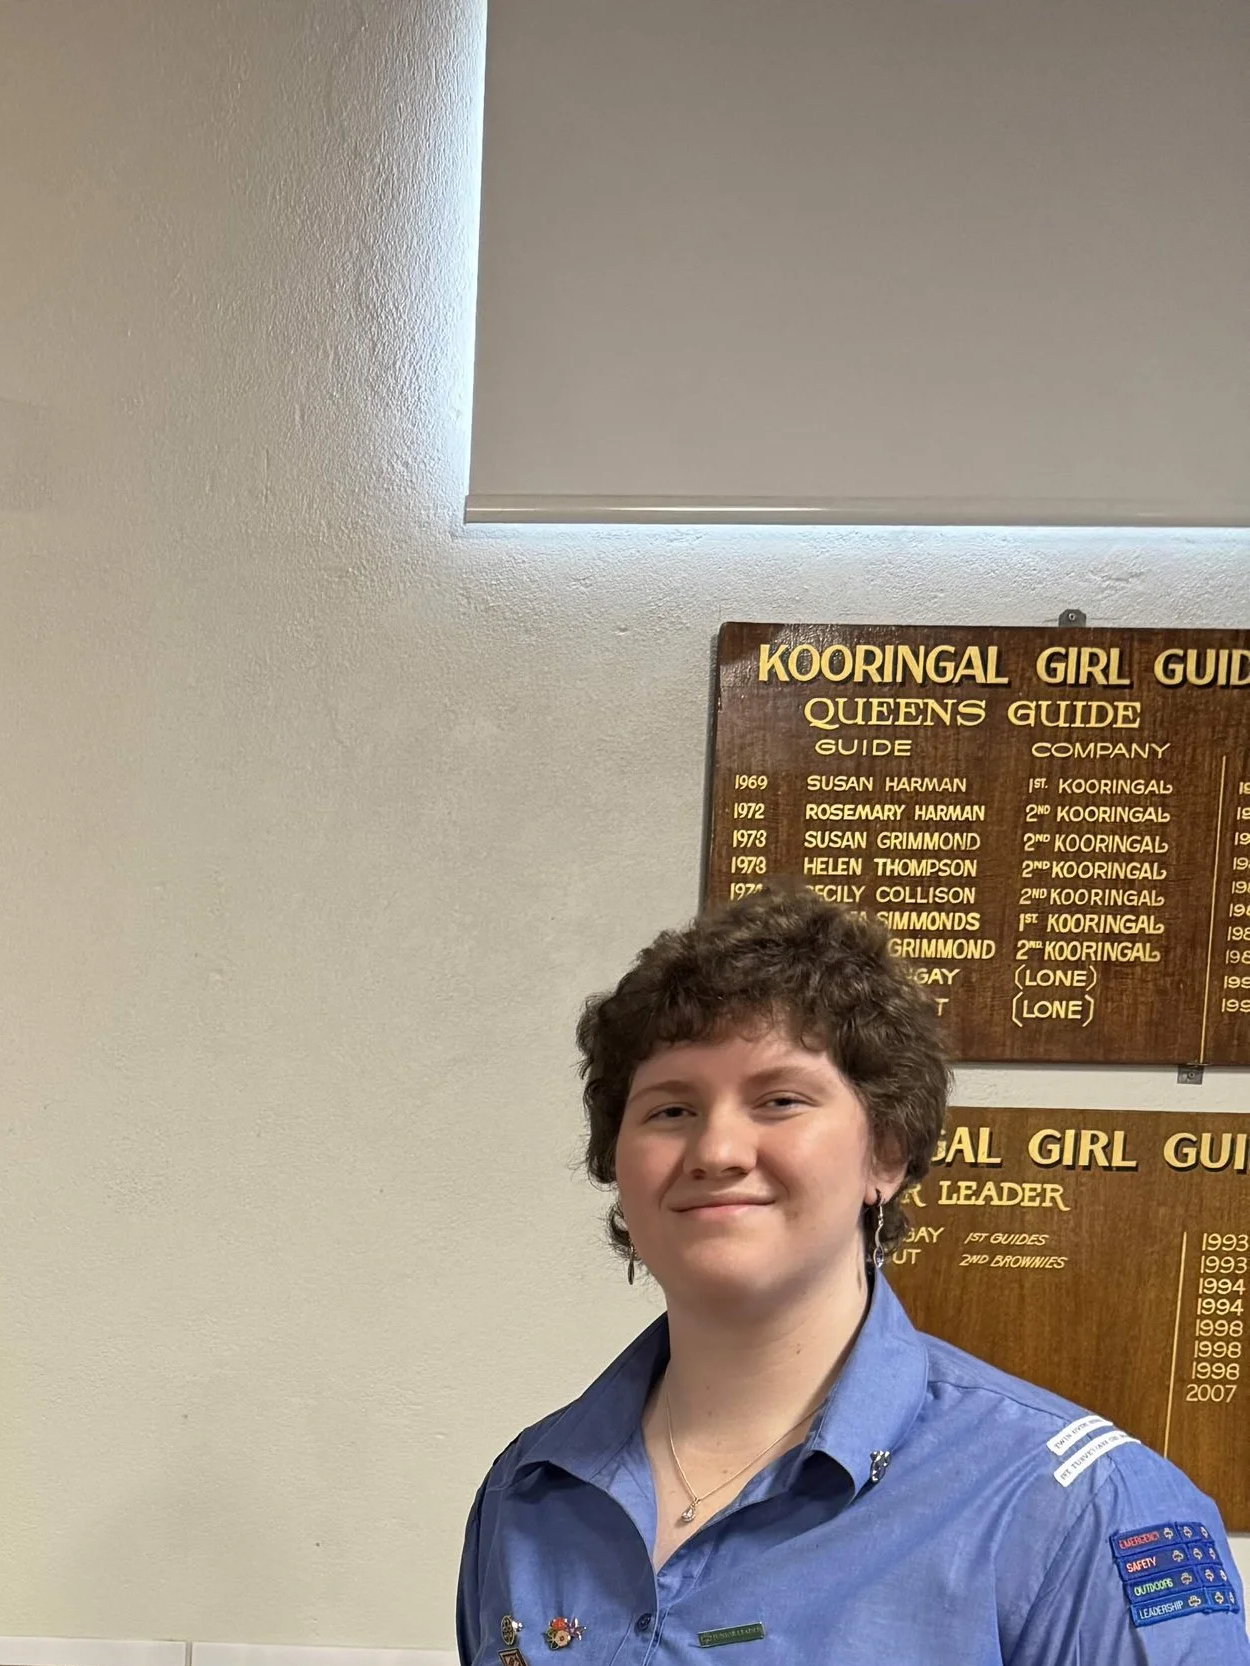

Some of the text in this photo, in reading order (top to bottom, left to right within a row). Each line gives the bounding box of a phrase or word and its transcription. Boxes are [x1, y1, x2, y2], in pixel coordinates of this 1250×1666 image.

[758, 644, 1008, 684] KOORINGAL
[1036, 647, 1130, 684] GIRL
[804, 698, 1141, 729] QUEENS GUIDE
[815, 739, 1170, 758] GUIDE COMPANY
[735, 775, 767, 789] 1969
[808, 775, 873, 791] SUSAN
[886, 777, 966, 792] HARMAN
[1059, 779, 1172, 794] KOORINGAL
[734, 803, 764, 818] 1972
[806, 804, 905, 820] ROSEMARY
[915, 805, 984, 820] HARMAN
[1057, 806, 1170, 822] KOORINGAL
[733, 830, 766, 847] 1973
[805, 831, 866, 848] SUSAN
[877, 832, 980, 850] GRIMMOND
[1054, 834, 1168, 853] KOORINGAL
[732, 856, 766, 873] 1973
[804, 857, 862, 875] HELEN
[874, 858, 976, 876] THOMPSON
[1052, 861, 1166, 879] KOORINGAL
[876, 887, 975, 903] COLLISON
[1050, 889, 1164, 906] KOORINGAL
[1047, 914, 1164, 934] KOORINGAL
[889, 939, 995, 960] GRIMMOND
[1045, 941, 1160, 961] KOORINGAL
[1015, 964, 1096, 991] (LONE)
[1012, 992, 1094, 1027] (LONE)
[1028, 1129, 1138, 1167] GIRL
[938, 1181, 1070, 1211] LEADER
[964, 1233, 1049, 1246] 1ST GUIDES
[1202, 1233, 1248, 1251] 1993
[990, 1255, 1068, 1268] BROWNIES
[1201, 1256, 1247, 1273] 1993
[1199, 1278, 1245, 1295] 1994
[1197, 1298, 1243, 1315] 1994
[1196, 1319, 1243, 1337] 1998
[1194, 1341, 1241, 1358] 1998
[1192, 1362, 1239, 1380] 1998
[1186, 1384, 1237, 1402] 2007
[1126, 1557, 1156, 1573] SAFETY
[1140, 1600, 1183, 1619] LEADERSHIP
